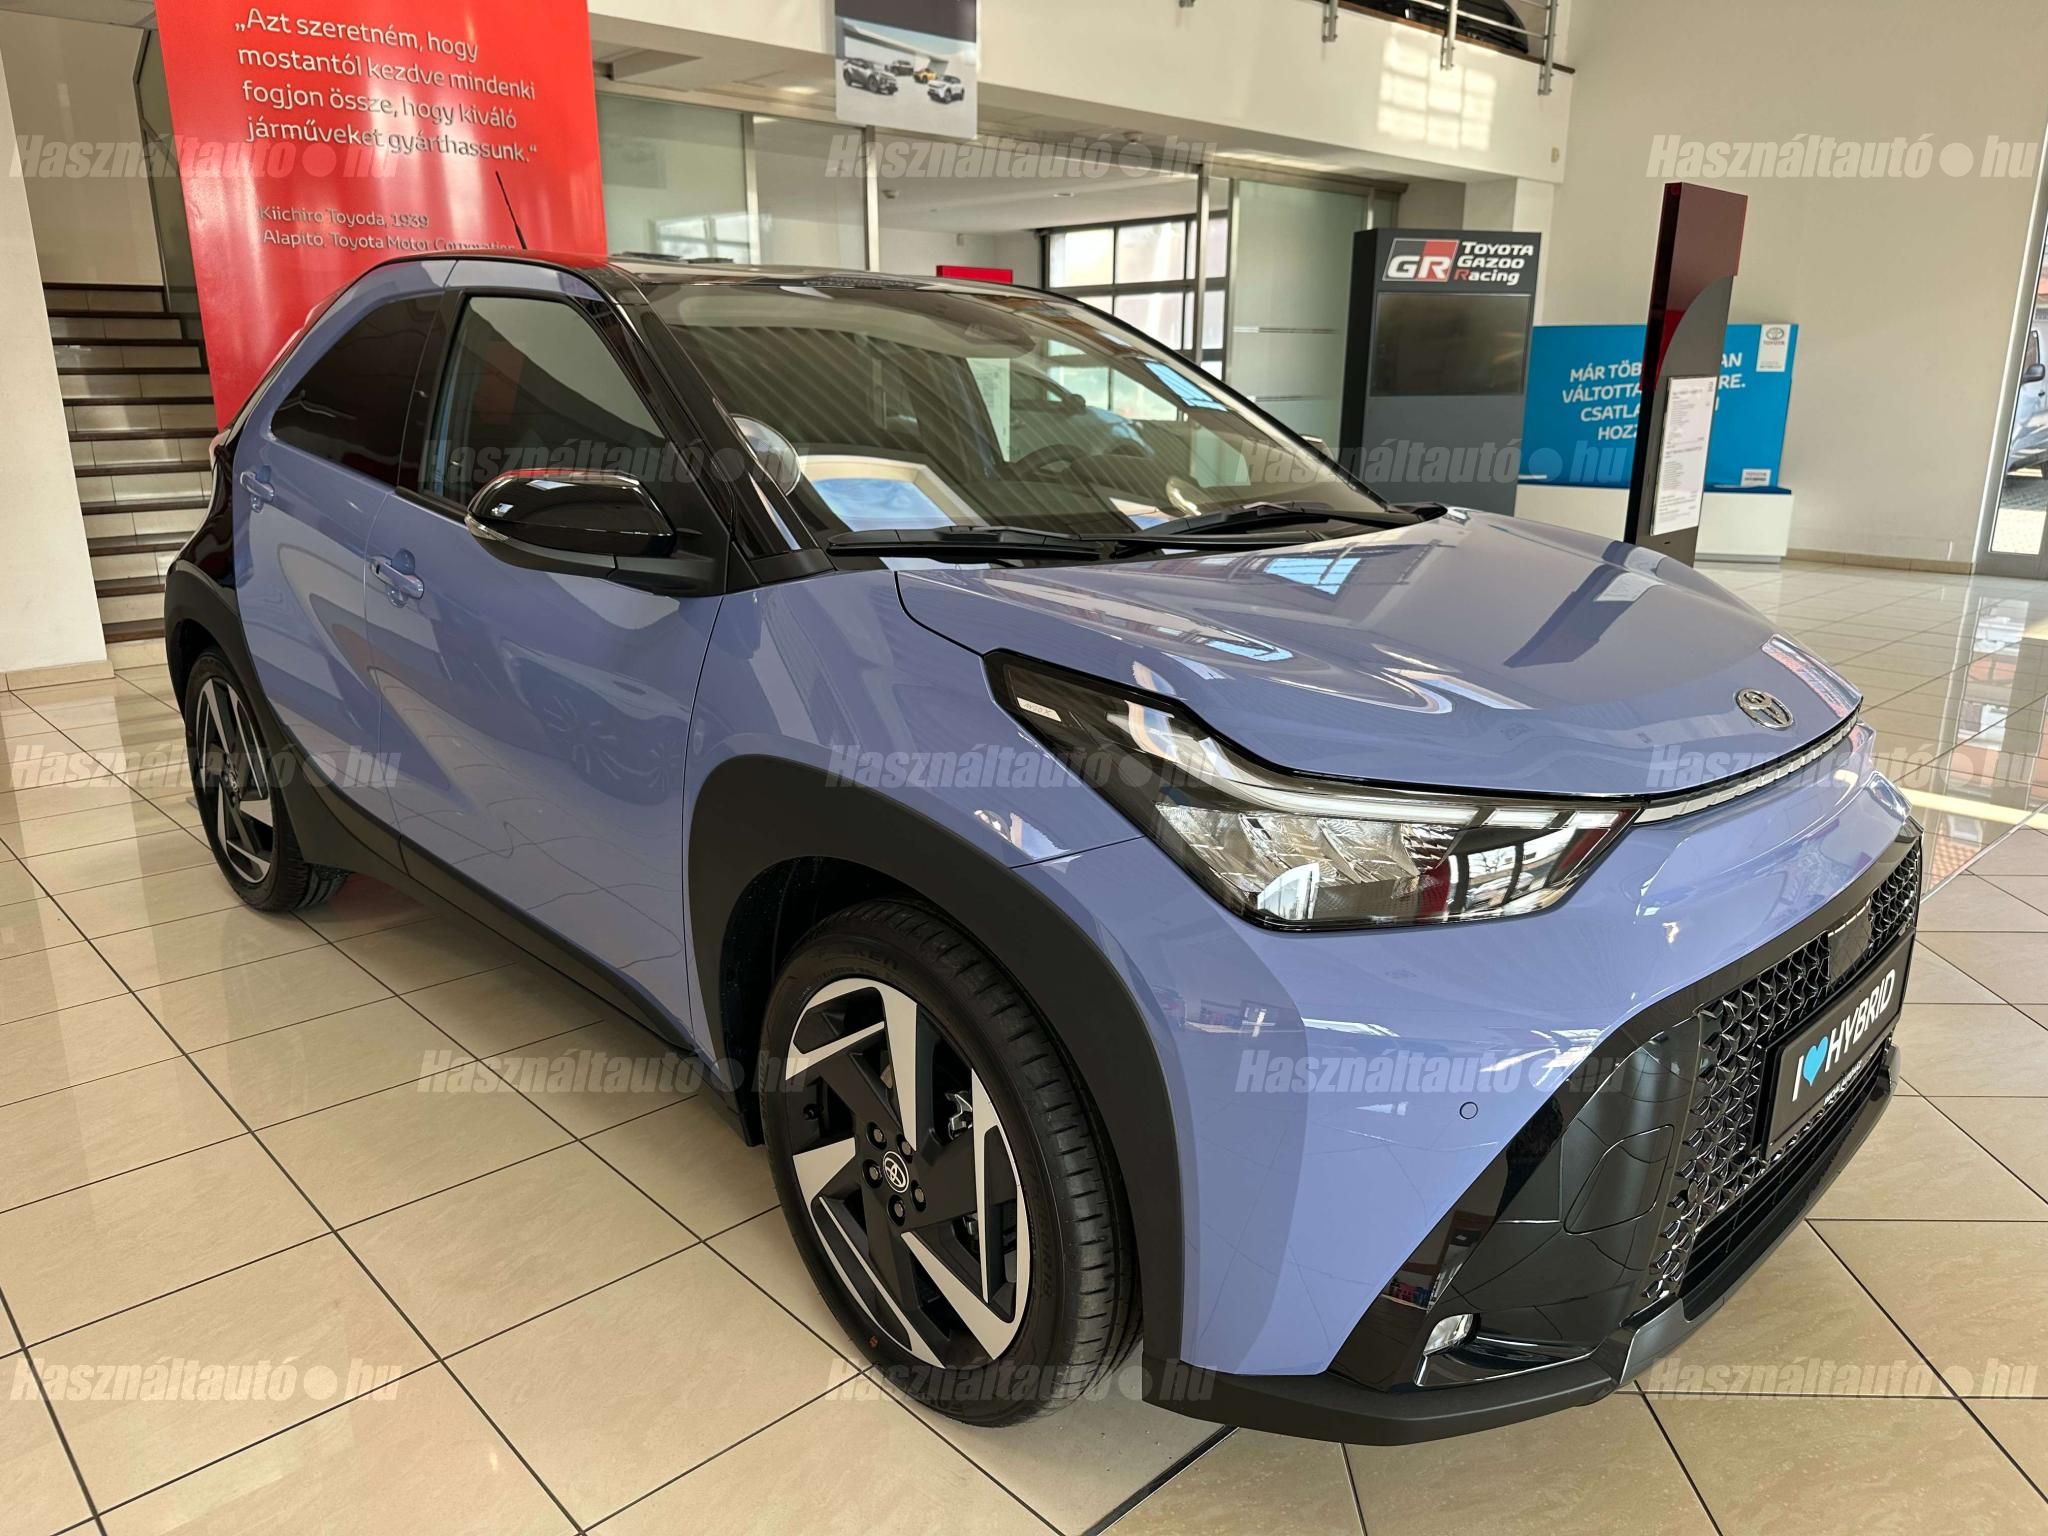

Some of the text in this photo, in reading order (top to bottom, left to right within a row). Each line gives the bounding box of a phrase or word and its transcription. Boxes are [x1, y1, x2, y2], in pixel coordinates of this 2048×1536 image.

[296, 18, 423, 52] szeretném,
[427, 32, 478, 64] hogy
[238, 48, 536, 100] mostantól kezdve mindenki
[242, 81, 517, 130] fogjon össze, hogy kiváló
[246, 116, 383, 147] járműveket
[258, 206, 430, 229] Kiichiro Toyoda, 1939
[329, 231, 384, 250] Toyota
[1462, 241, 1534, 256] TOYOTA
[1387, 255, 1450, 279] GR
[1457, 254, 1525, 269] GAZOO
[1454, 268, 1520, 286] Racing
[1570, 362, 1606, 383] MÁR
[1824, 968, 1897, 1073] HYBRID
